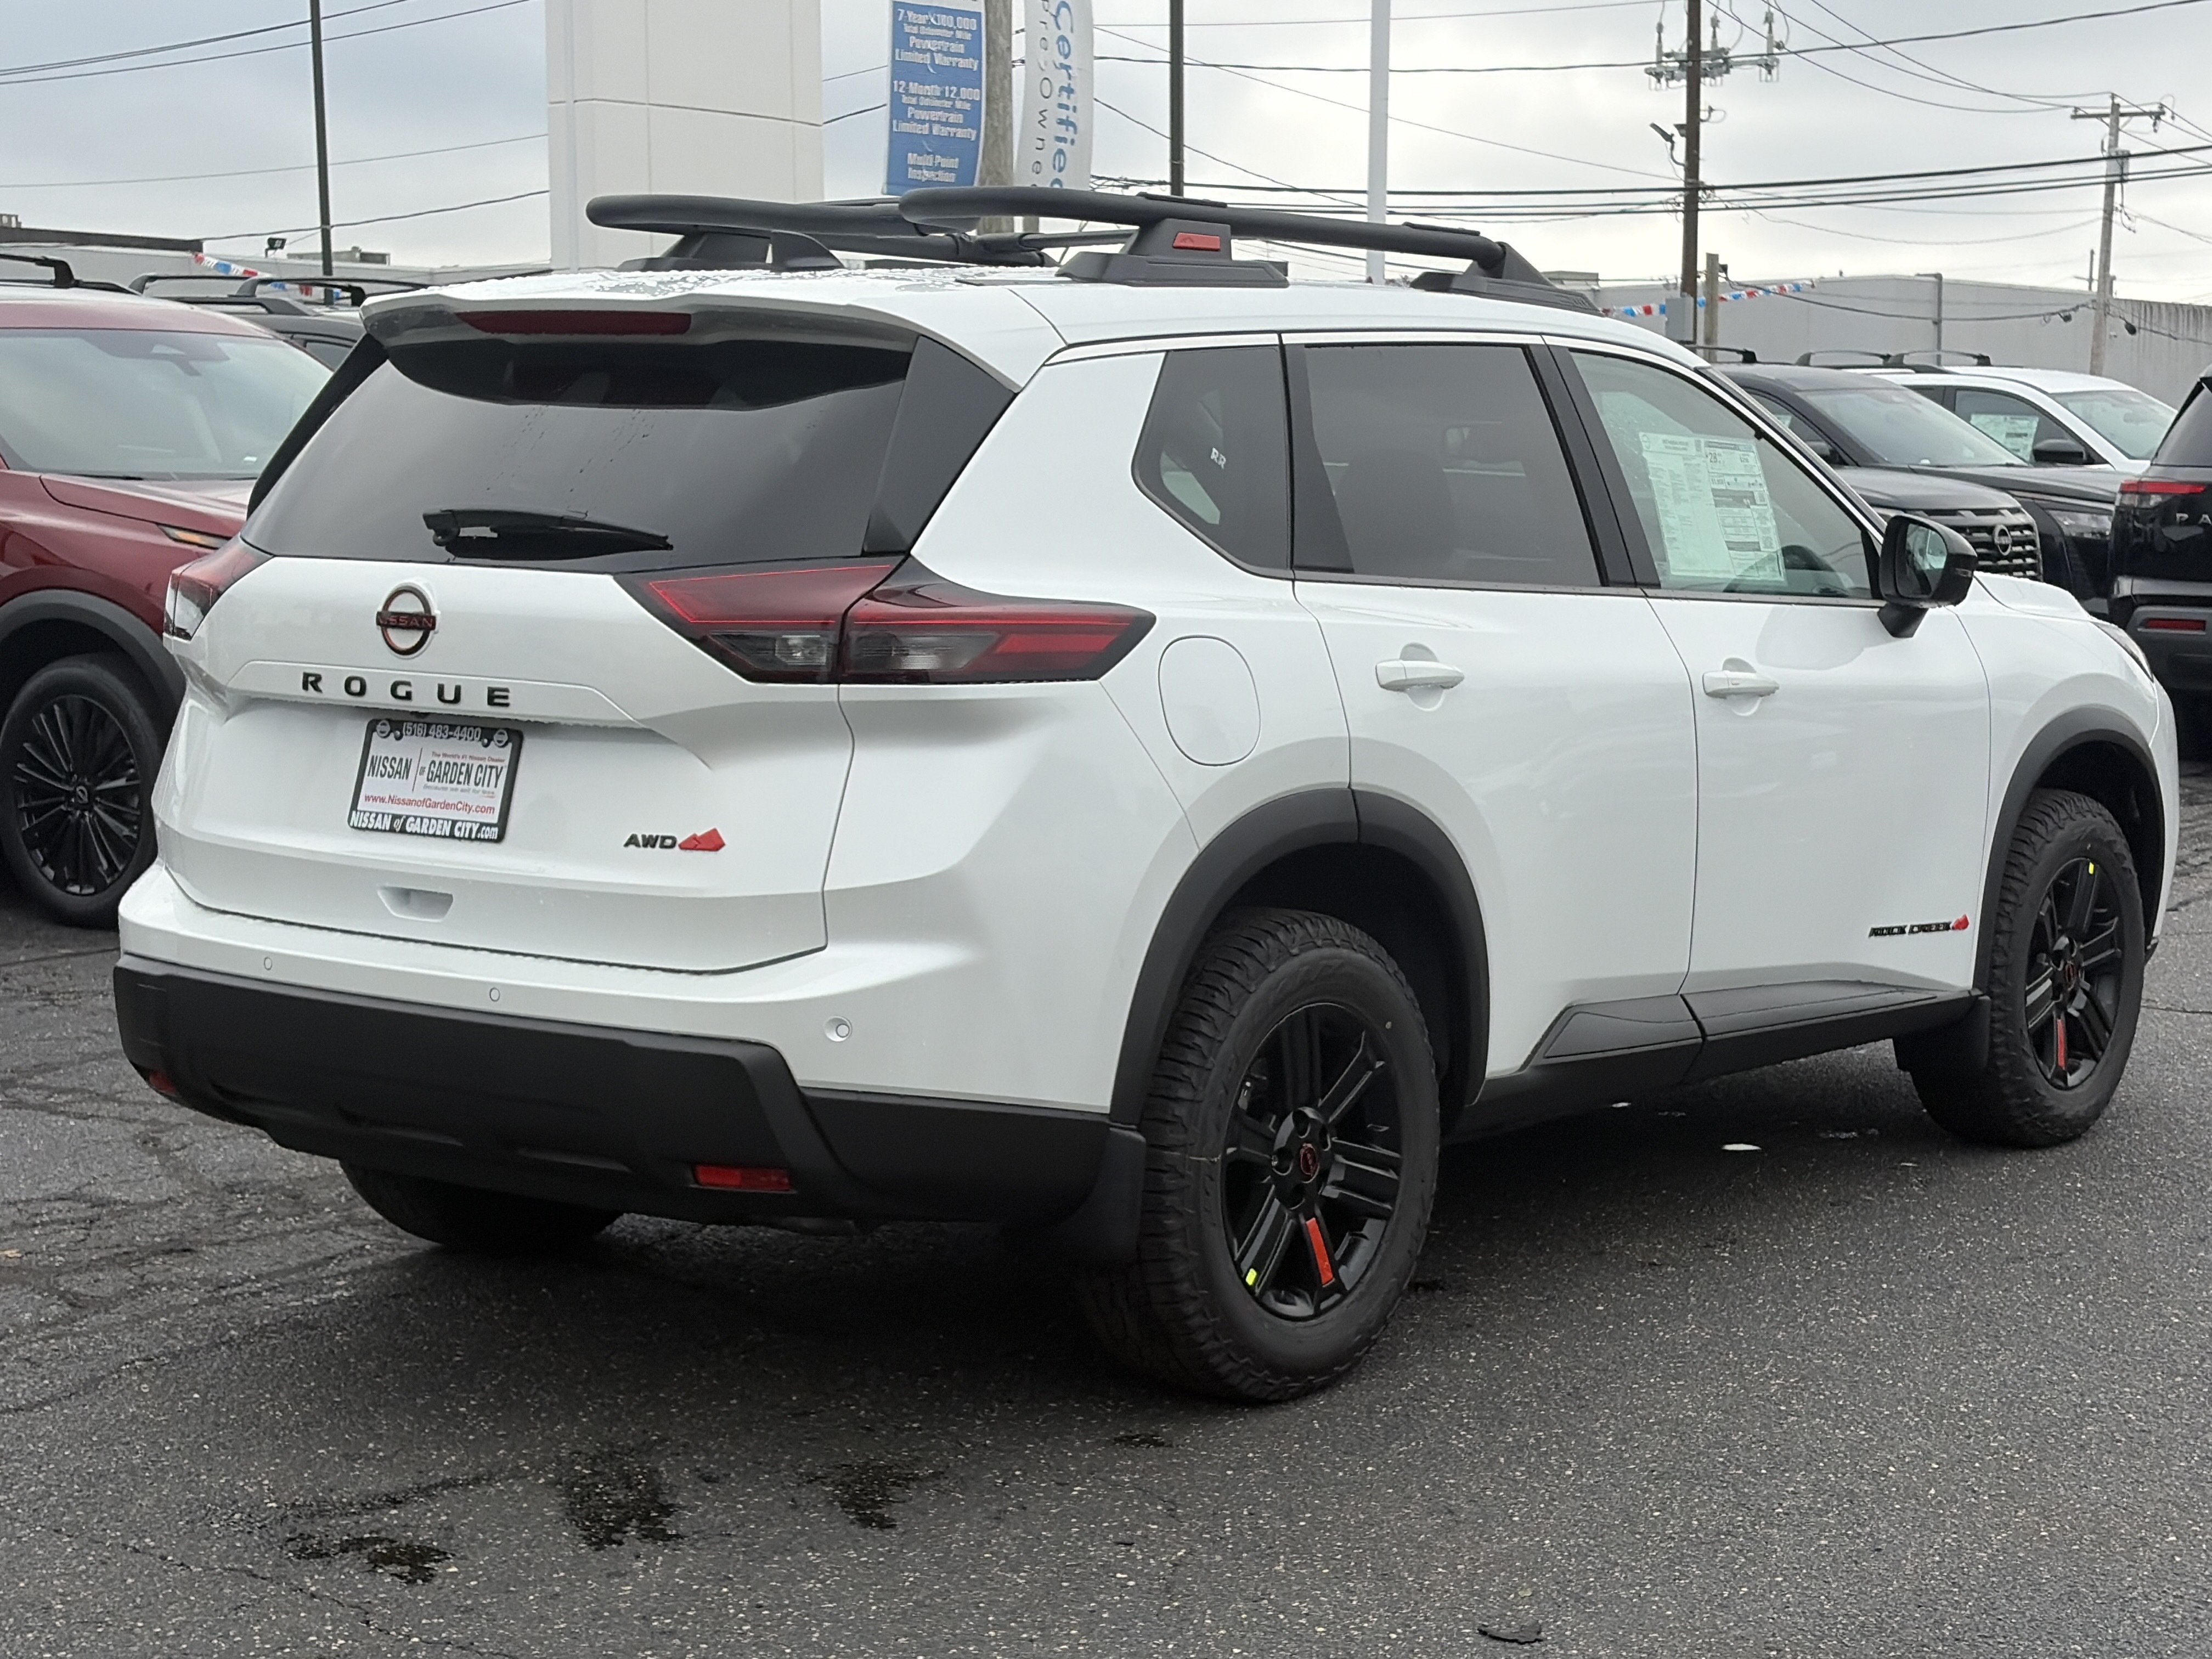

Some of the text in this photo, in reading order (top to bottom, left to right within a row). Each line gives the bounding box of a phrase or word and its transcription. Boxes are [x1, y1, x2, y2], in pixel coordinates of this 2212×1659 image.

[2176, 513, 2212, 525] PA
[302, 672, 510, 707] ROGUE
[403, 723, 481, 741] (516) 483-4400
[368, 755, 412, 780] NISSAN
[426, 760, 473, 786] GARDEN
[474, 764, 503, 788] CITY
[364, 794, 495, 815] www.NissanofGardenCity.com
[349, 810, 499, 840] NISSAN of GARDEN CITY.com
[623, 833, 677, 849] AWD
